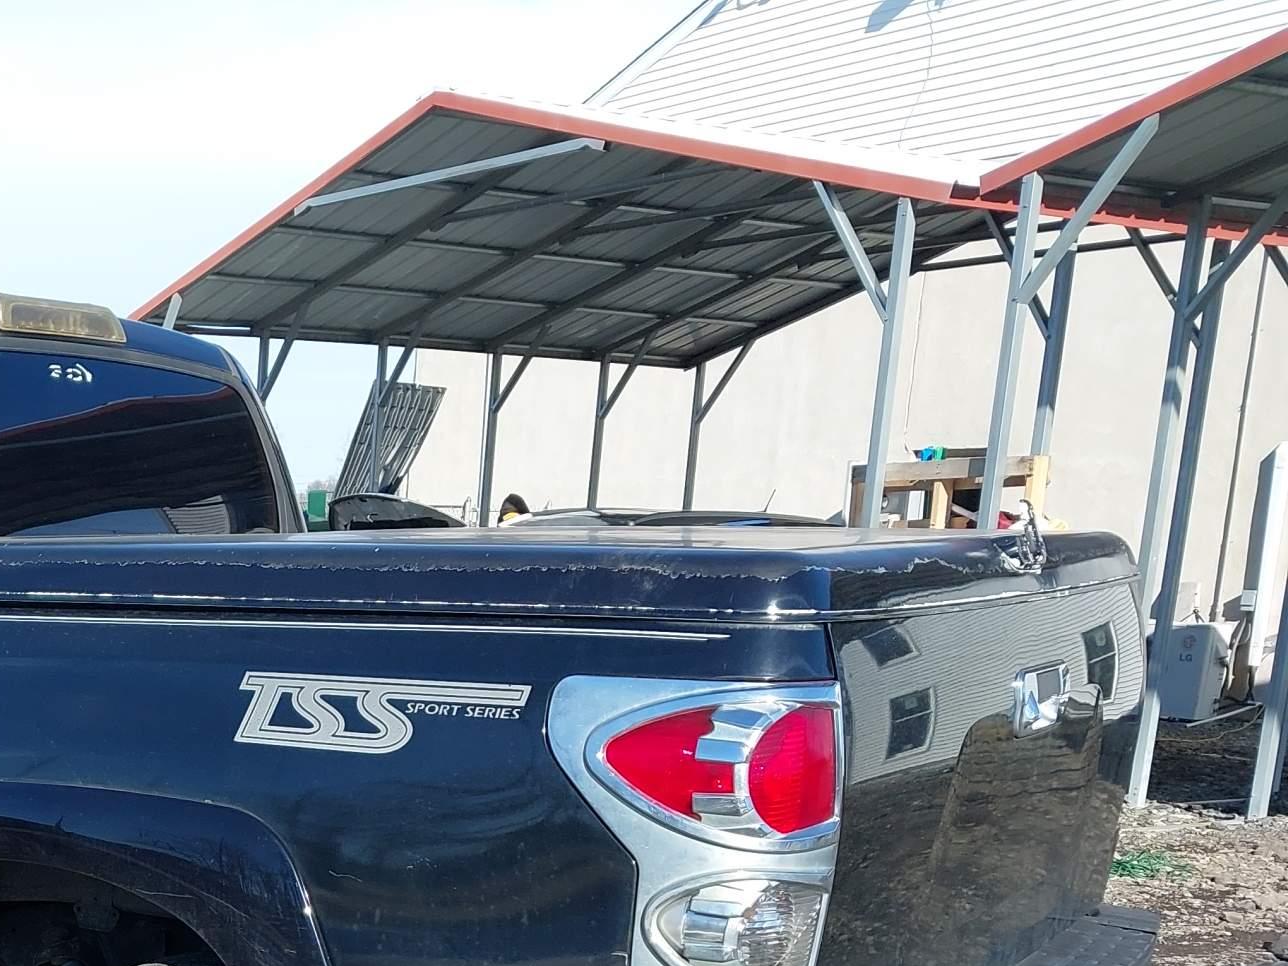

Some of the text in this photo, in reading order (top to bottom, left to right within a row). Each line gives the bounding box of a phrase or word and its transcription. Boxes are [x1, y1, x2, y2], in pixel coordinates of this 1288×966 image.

[1178, 653, 1193, 662] LG
[405, 701, 522, 720] SPORT SERIES
